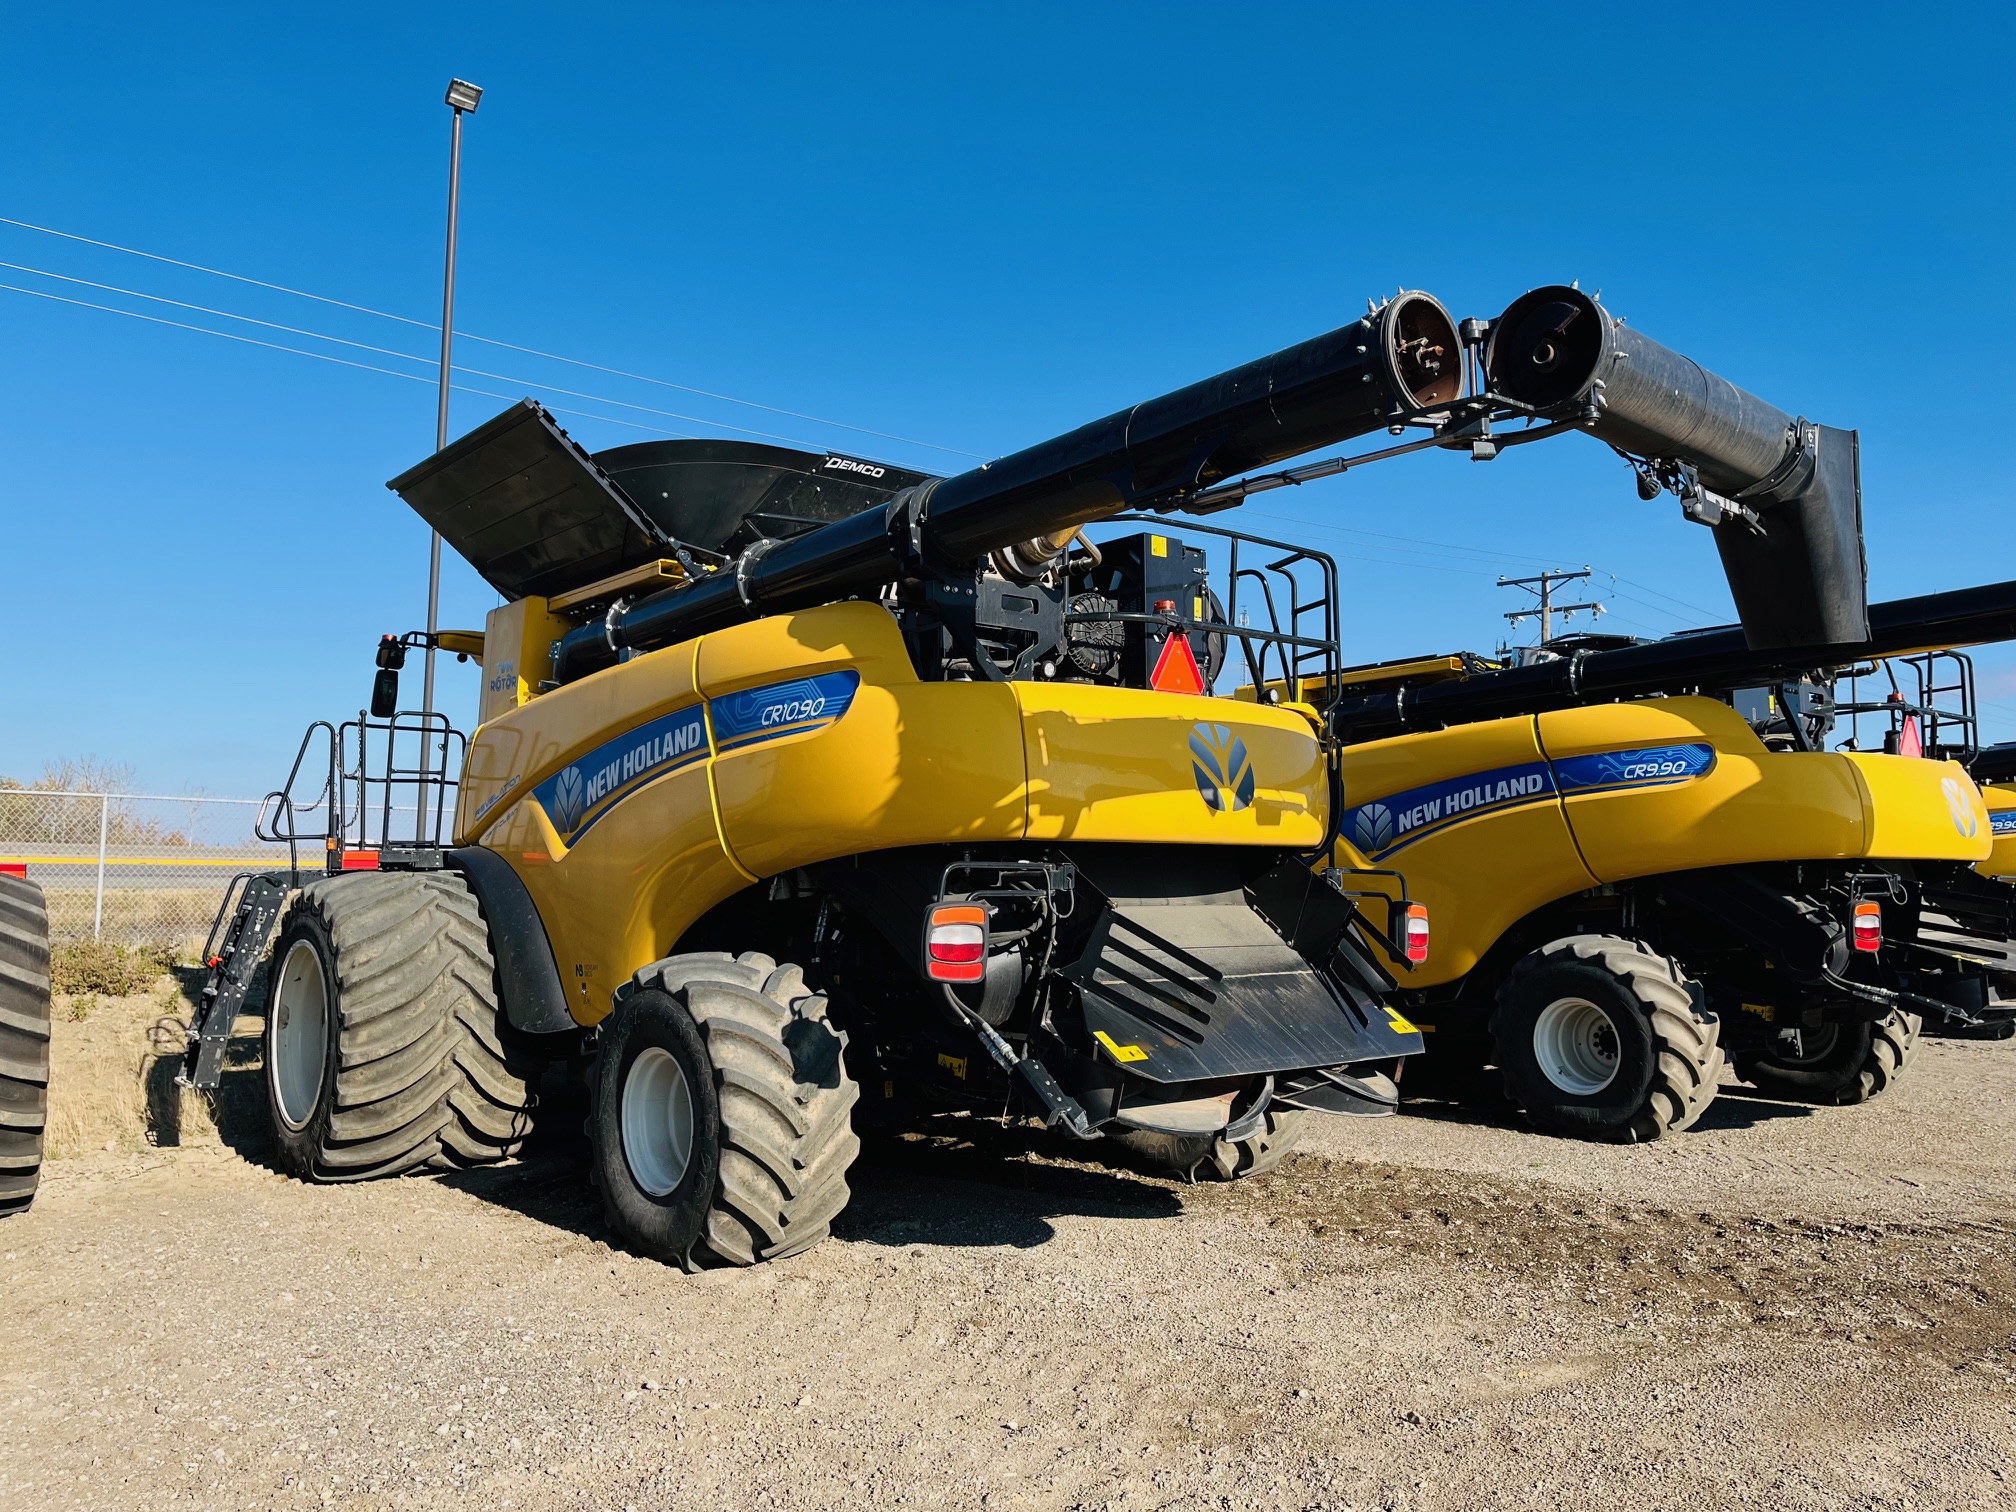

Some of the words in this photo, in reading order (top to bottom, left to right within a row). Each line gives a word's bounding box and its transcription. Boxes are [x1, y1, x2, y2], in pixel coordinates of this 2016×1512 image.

[824, 457, 885, 478] DEMCO
[495, 661, 514, 674] TWIN
[490, 674, 517, 692] ROTOR
[761, 697, 826, 726] CR10.90
[586, 758, 620, 808] NEW
[623, 721, 701, 781] HOLLAND
[1624, 761, 1687, 779] CR9.90
[1398, 799, 1441, 833] NEW
[1445, 773, 1543, 815] HOLLAND
